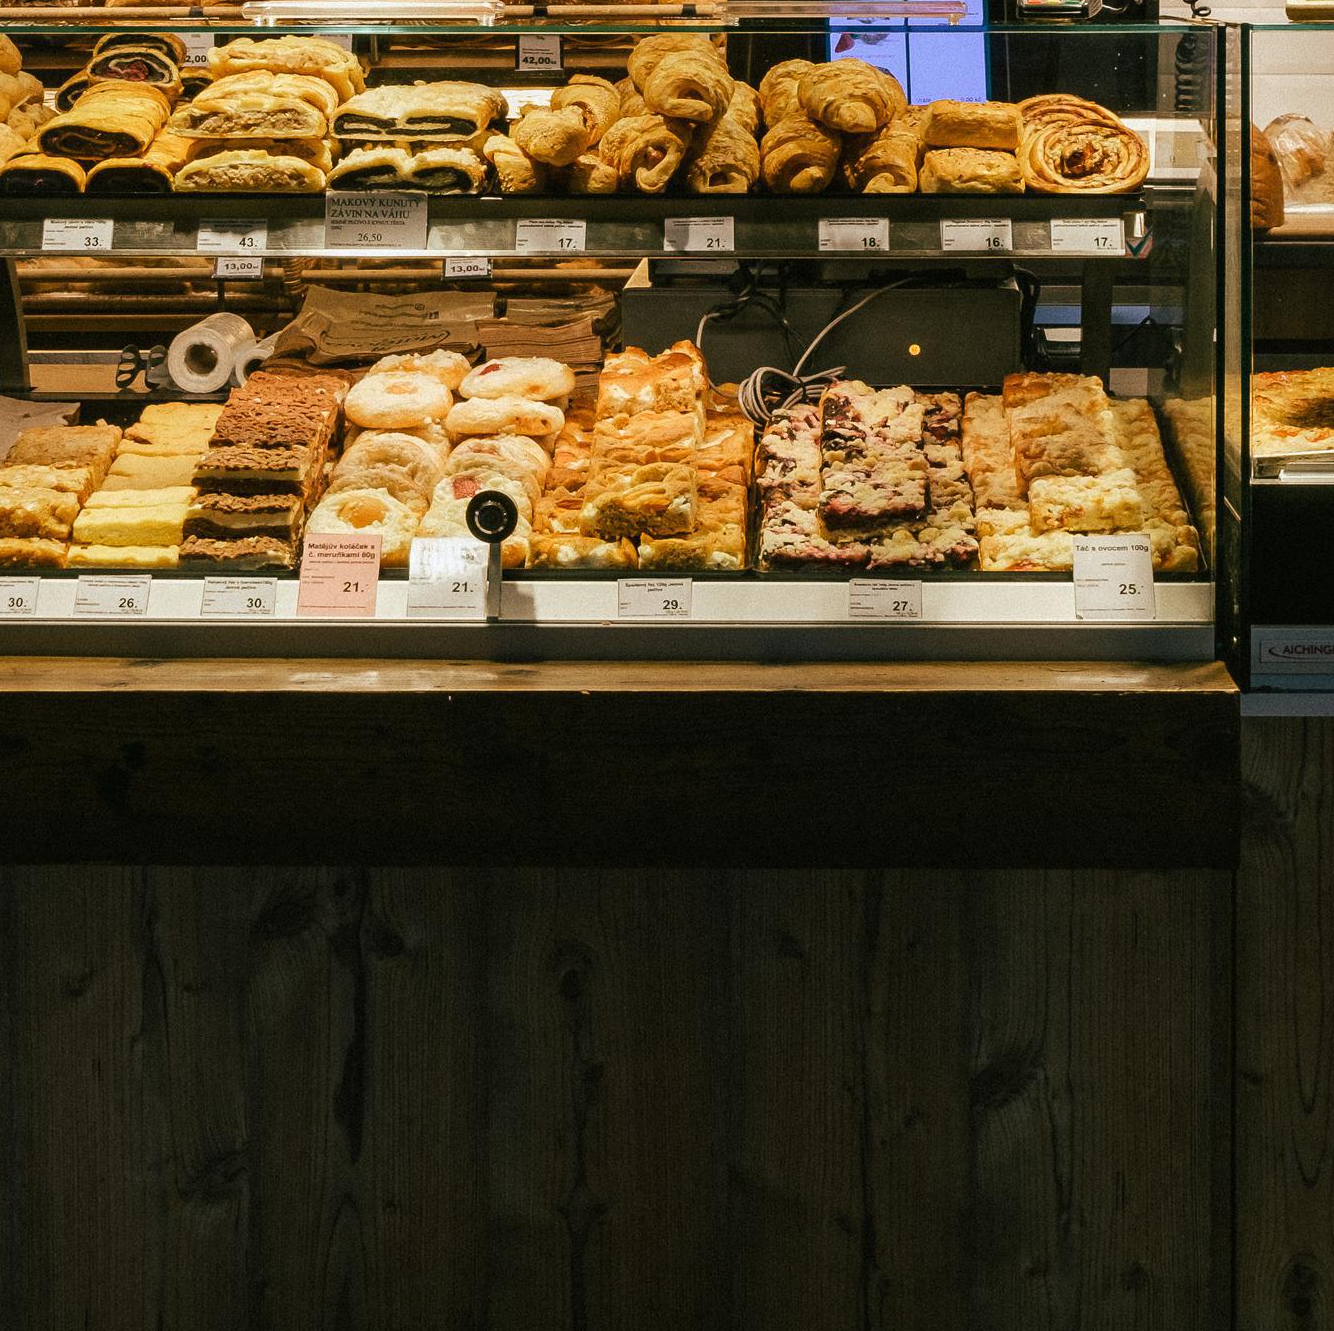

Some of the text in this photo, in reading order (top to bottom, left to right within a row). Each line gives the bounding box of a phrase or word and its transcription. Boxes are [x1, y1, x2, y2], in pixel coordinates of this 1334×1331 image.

[330, 196, 376, 208] MAKOVÝ
[330, 208, 410, 219] ZÁVIN NA VÁHU
[357, 232, 382, 244] 26,50
[339, 541, 369, 550] koláček
[1131, 544, 1149, 553] 100g
